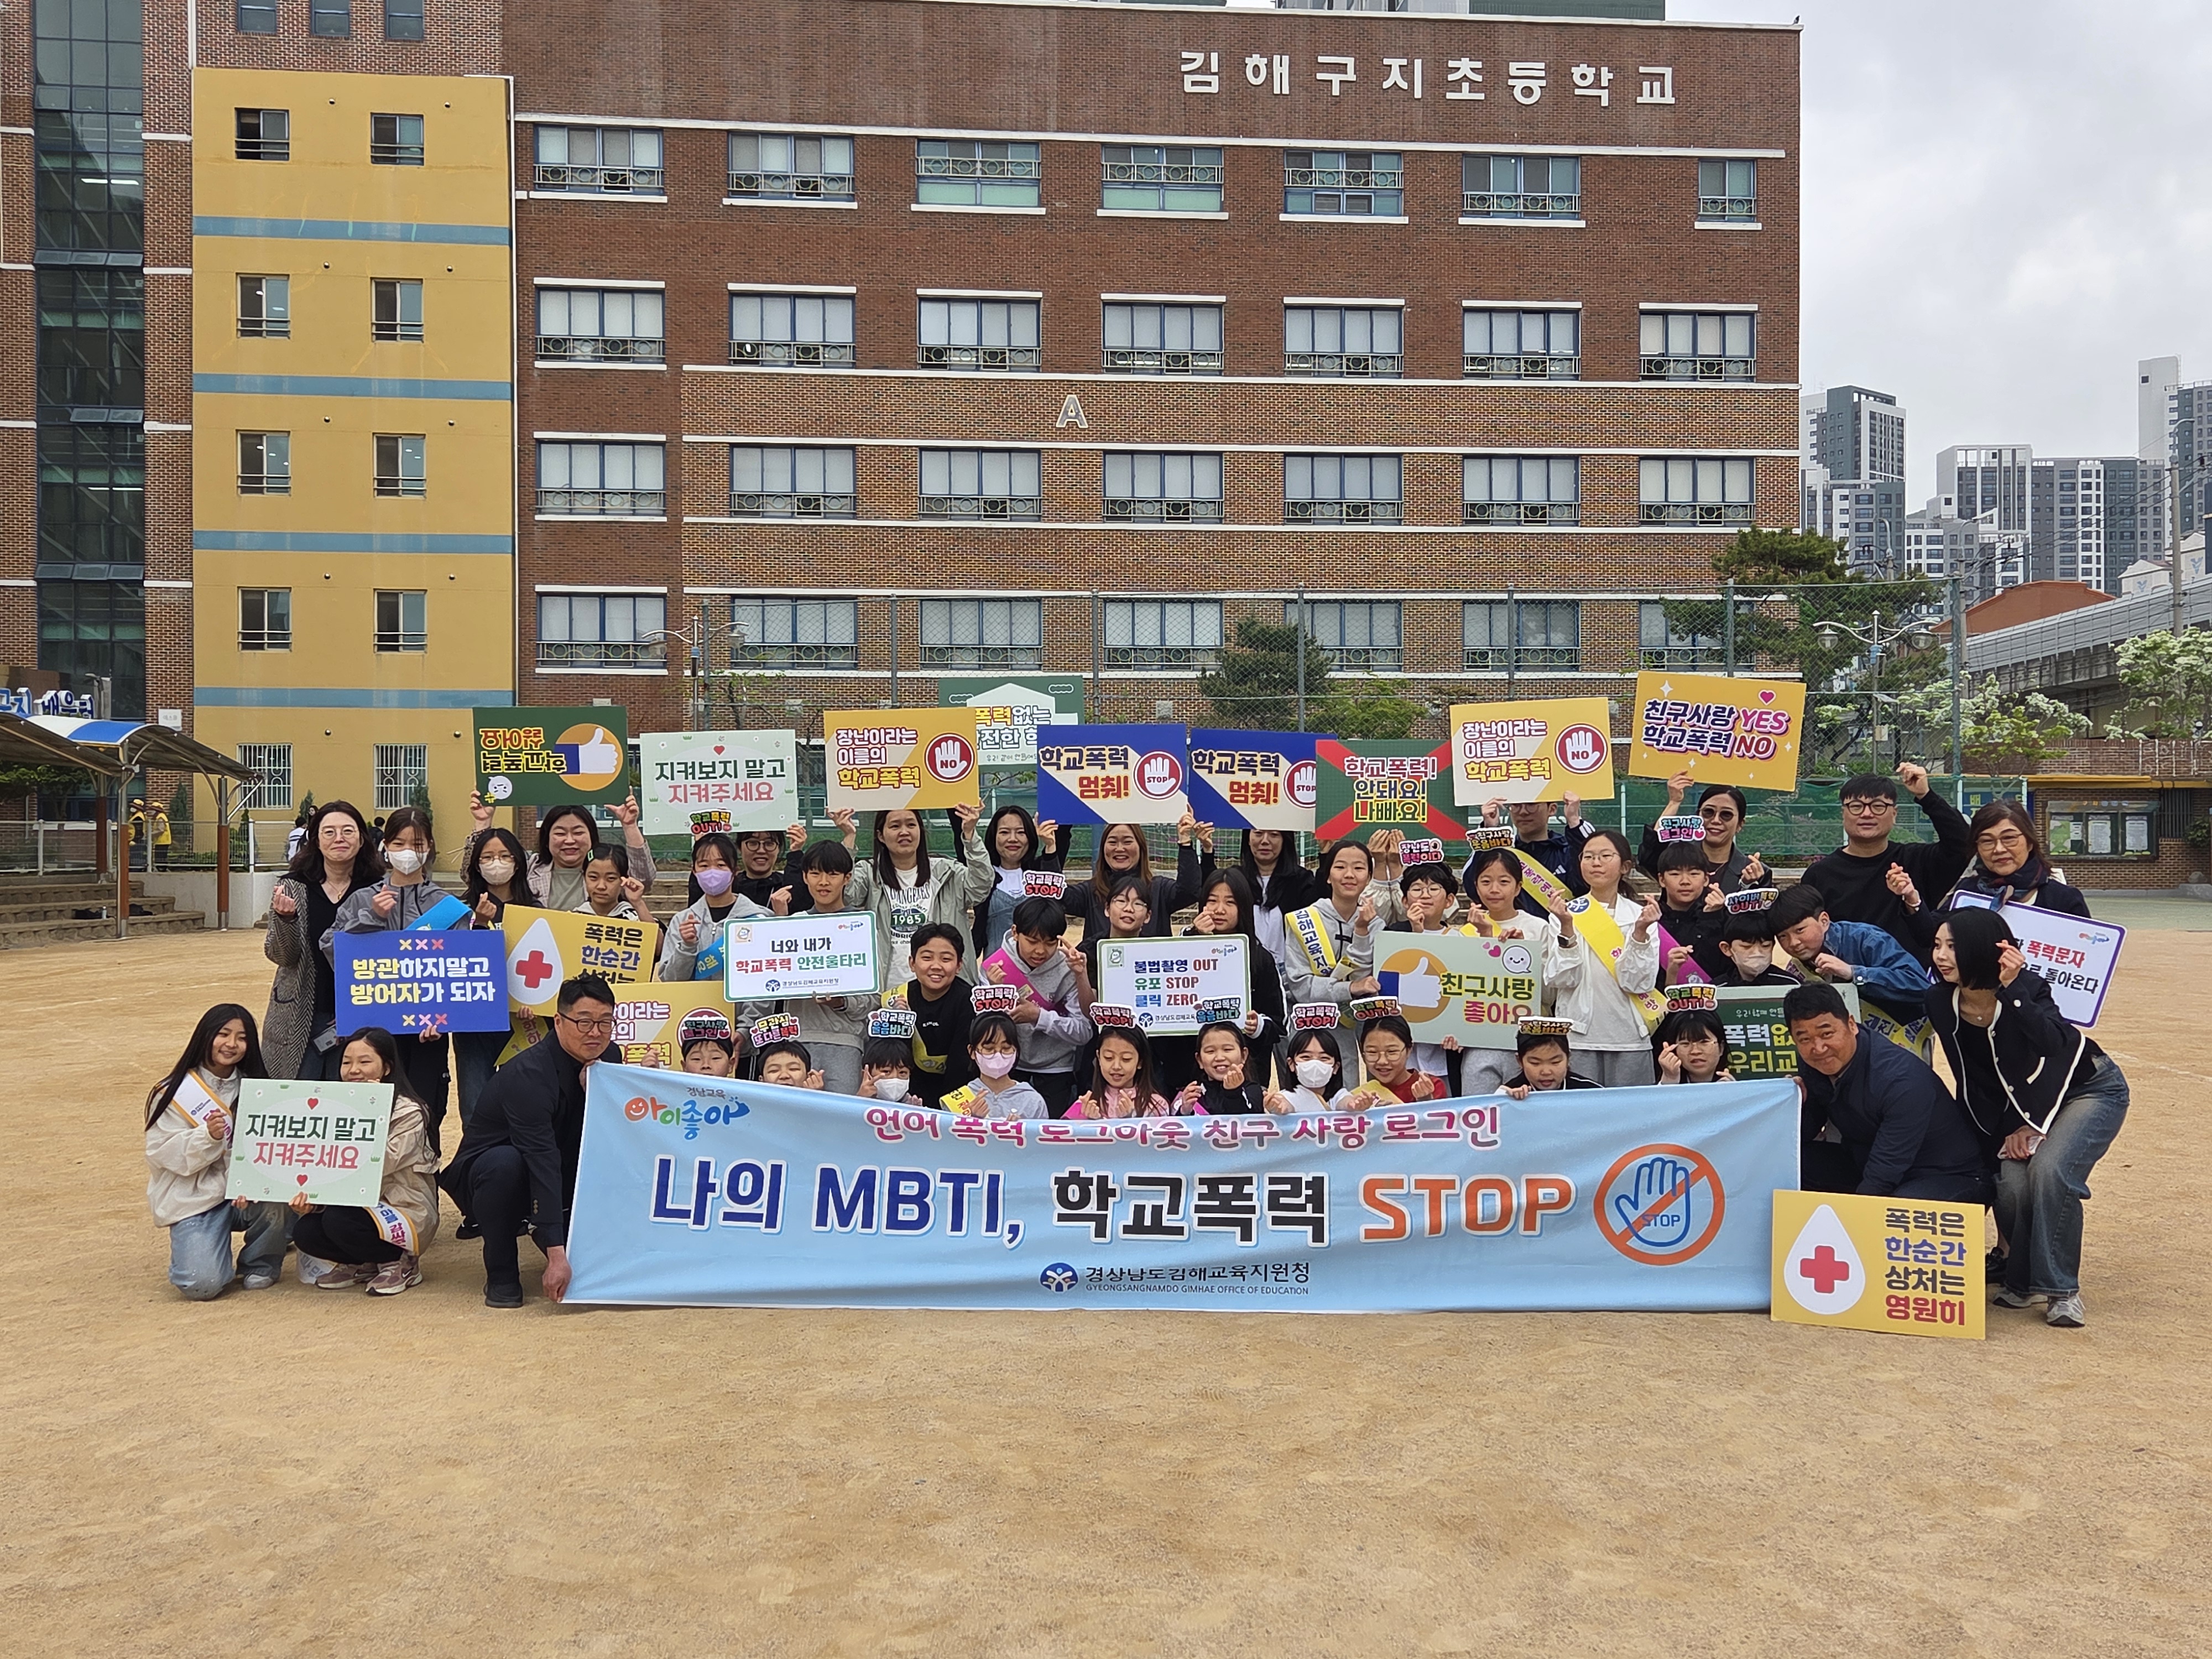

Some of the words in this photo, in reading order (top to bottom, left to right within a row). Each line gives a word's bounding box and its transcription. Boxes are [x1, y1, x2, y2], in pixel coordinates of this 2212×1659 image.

[1180, 50, 1676, 107] 김해구지초등학교
[1055, 394, 1089, 429] A
[1644, 700, 1737, 728] 친구사랑
[1741, 709, 1787, 731] YES
[836, 727, 919, 746] 장난이라는
[976, 728, 1020, 750] 전한
[1463, 719, 1548, 739] 장난이라는
[1464, 739, 1516, 759] 이름의
[1642, 726, 1733, 753] 학교폭력
[1735, 735, 1772, 756] NO
[480, 750, 567, 774] 학교폭력
[837, 747, 887, 765] 이름의
[940, 759, 957, 769] NO
[1039, 746, 1130, 771] 학교폭력
[1192, 749, 1280, 777] 학교폭력
[1571, 750, 1589, 760] NO
[655, 760, 738, 781] 지켜보지
[745, 759, 786, 779] 말고
[838, 766, 921, 790] 학교폭력
[1345, 757, 1437, 780] 학교폭력!
[1465, 758, 1552, 783] 학교폭력
[668, 781, 774, 804] 지켜주세요
[1078, 775, 1130, 800] 멈춰!
[1229, 781, 1279, 805] 멈춰!
[1354, 779, 1427, 801] 안돼요!
[1354, 801, 1427, 823] 나빠요!
[1660, 828, 1692, 840] 로그인
[1662, 817, 1702, 830] 친구사랑
[1025, 884, 1062, 897] STOP!
[1026, 873, 1062, 887] 학교폭력
[892, 914, 921, 925] 1985
[585, 922, 643, 948] 폭력은
[771, 939, 799, 953] 너와
[804, 937, 832, 952] 내가
[582, 945, 640, 971] 한순간
[735, 957, 792, 974] 학교폭력
[797, 952, 867, 971] 안전울타리
[1193, 958, 1219, 972] OUT
[2027, 940, 2086, 969] 폭력문자
[352, 957, 491, 980] 방관하지말고
[350, 982, 445, 1005] 방어자가
[450, 981, 496, 1002] 되자
[975, 988, 1015, 1000] 학교폭력
[1135, 977, 1162, 990] 유포
[1166, 977, 1199, 989] STOP
[1441, 973, 1535, 1000] 친구사랑
[613, 1001, 671, 1020] 이라는
[975, 998, 1014, 1011] STOP!
[1135, 994, 1162, 1008] 클릭
[1166, 993, 1198, 1006] ZERO
[1094, 1015, 1133, 1027] STOP!
[1296, 1016, 1335, 1028] STOP!
[686, 1087, 727, 1100] 경남교육
[245, 1114, 328, 1140] 지켜보지
[334, 1117, 377, 1142] 말고
[867, 1108, 940, 1141] 언어
[1203, 1119, 1281, 1149] 친구
[1292, 1115, 1373, 1149] 사랑
[1381, 1106, 1501, 1148] 로그인
[253, 1142, 359, 1170] 지켜주세요
[652, 1157, 785, 1231] 나의
[813, 1166, 1024, 1245] MBTI,
[1053, 1169, 1328, 1245] 학교폭력
[1361, 1177, 1573, 1240] STOP
[1641, 1213, 1681, 1227] STOP
[1885, 1207, 1965, 1238] 폭력은
[1885, 1236, 1967, 1267] 한순간
[1085, 1262, 1310, 1284] 경상남도김해교육지원청
[1885, 1265, 1965, 1296] 상처는
[1085, 1284, 1179, 1294] GYEONGSANGNAMDO
[1181, 1285, 1215, 1293] GIMHAE
[1217, 1285, 1245, 1294] OFFICE
[1247, 1285, 1259, 1295] OF
[1260, 1285, 1310, 1295] EDUCATION
[1885, 1294, 1965, 1326] 영원히
